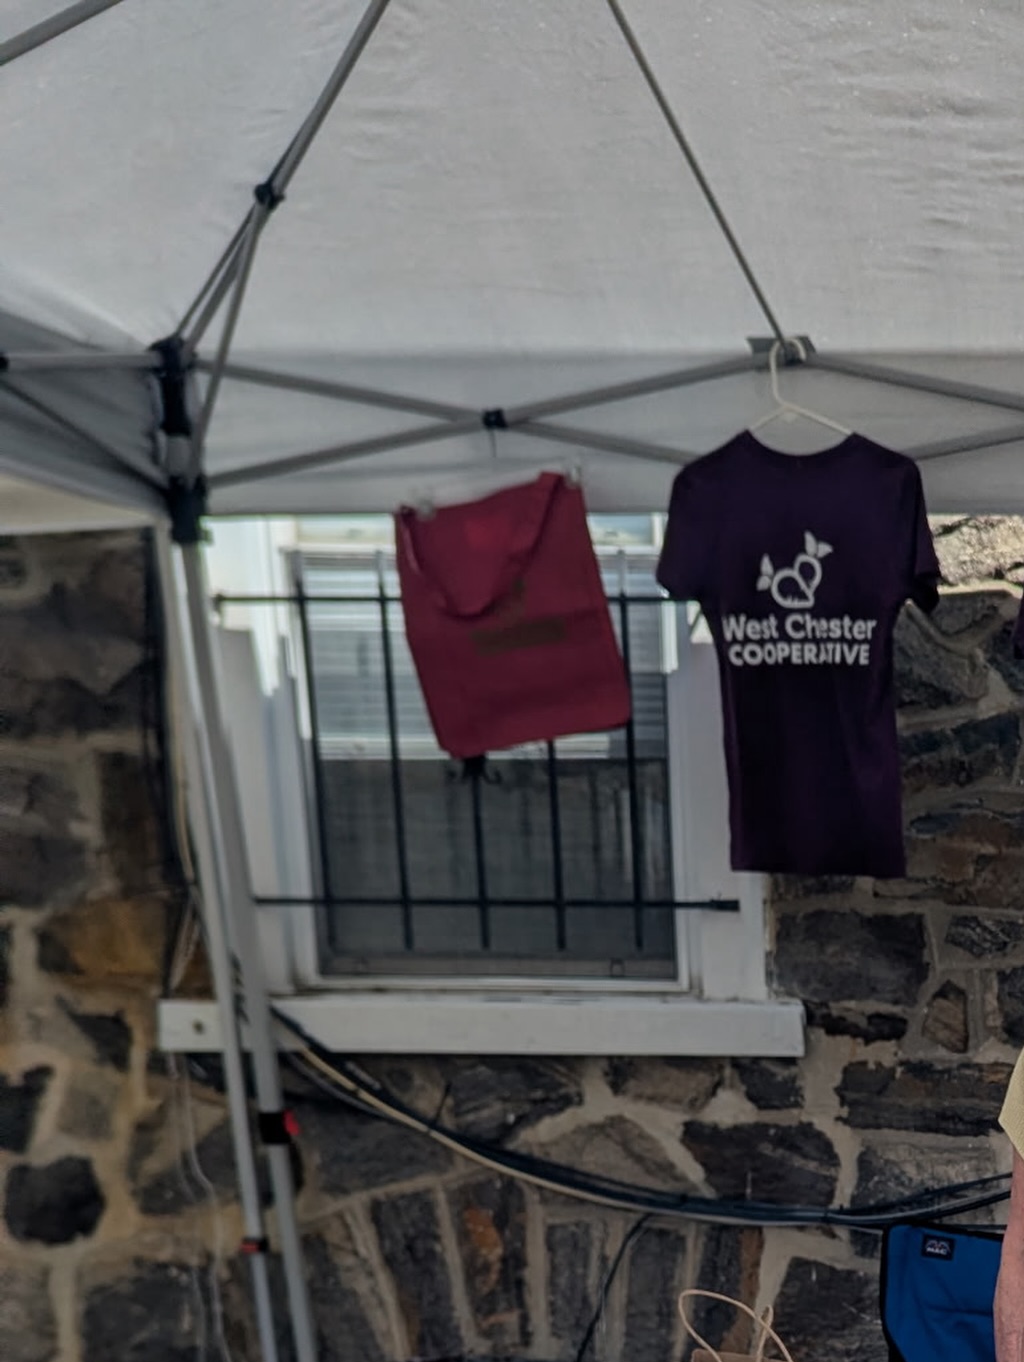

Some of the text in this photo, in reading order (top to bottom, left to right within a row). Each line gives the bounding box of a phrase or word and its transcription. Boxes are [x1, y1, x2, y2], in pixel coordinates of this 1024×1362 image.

[722, 612, 877, 642] West Chester
[728, 642, 870, 666] COOPERATIVE
